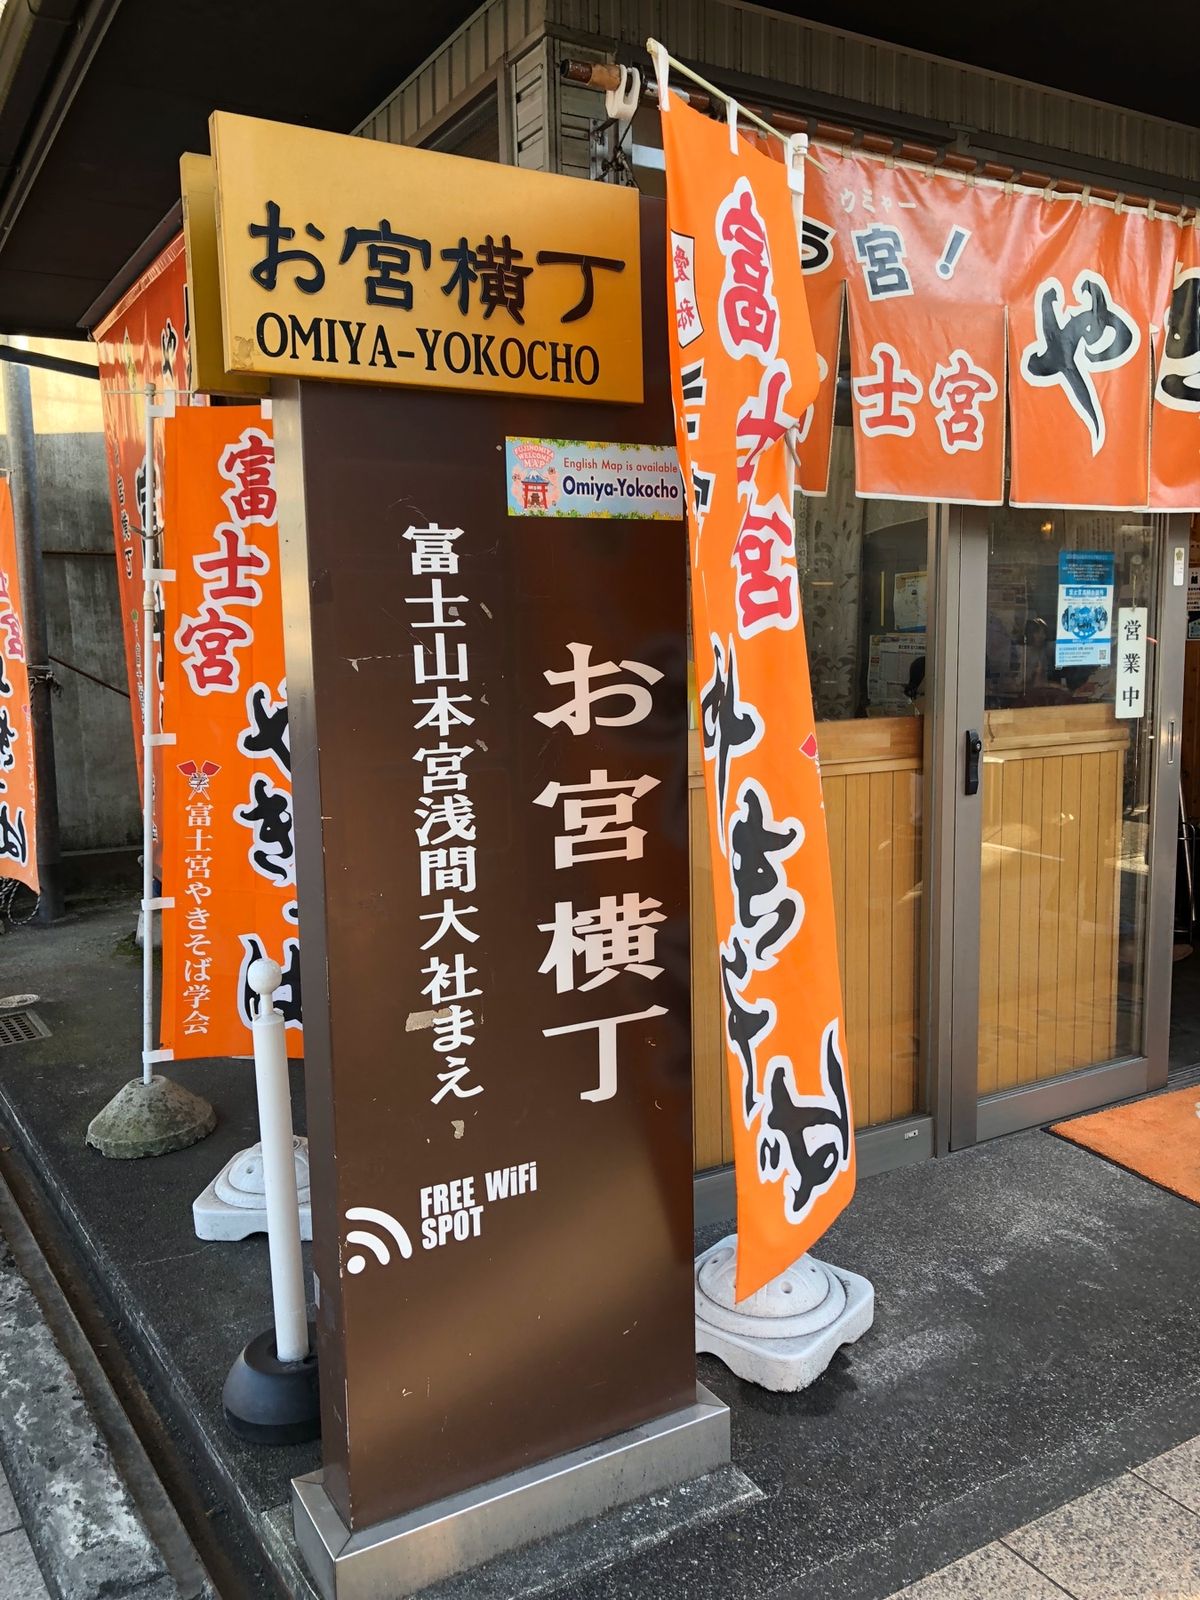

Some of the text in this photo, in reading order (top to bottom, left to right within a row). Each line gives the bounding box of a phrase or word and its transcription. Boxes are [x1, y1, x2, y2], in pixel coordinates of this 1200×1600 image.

[248, 199, 626, 327] お宮横丁
[256, 311, 601, 387] OMIYA-YOKOCHO
[523, 459, 546, 469] MAP
[562, 474, 679, 501] Omiya-Yokocho
[563, 457, 679, 474] English Map is available
[178, 432, 279, 690] 富士宮
[1121, 617, 1144, 709] 営業中
[401, 522, 485, 1105] 富士山本宮浅間大社まえ
[531, 640, 670, 1103] お宮横丁
[182, 801, 214, 1036] 富士宮やきそば学会
[419, 1160, 538, 1219] FREE WiFi
[420, 1204, 485, 1250] SPOT
